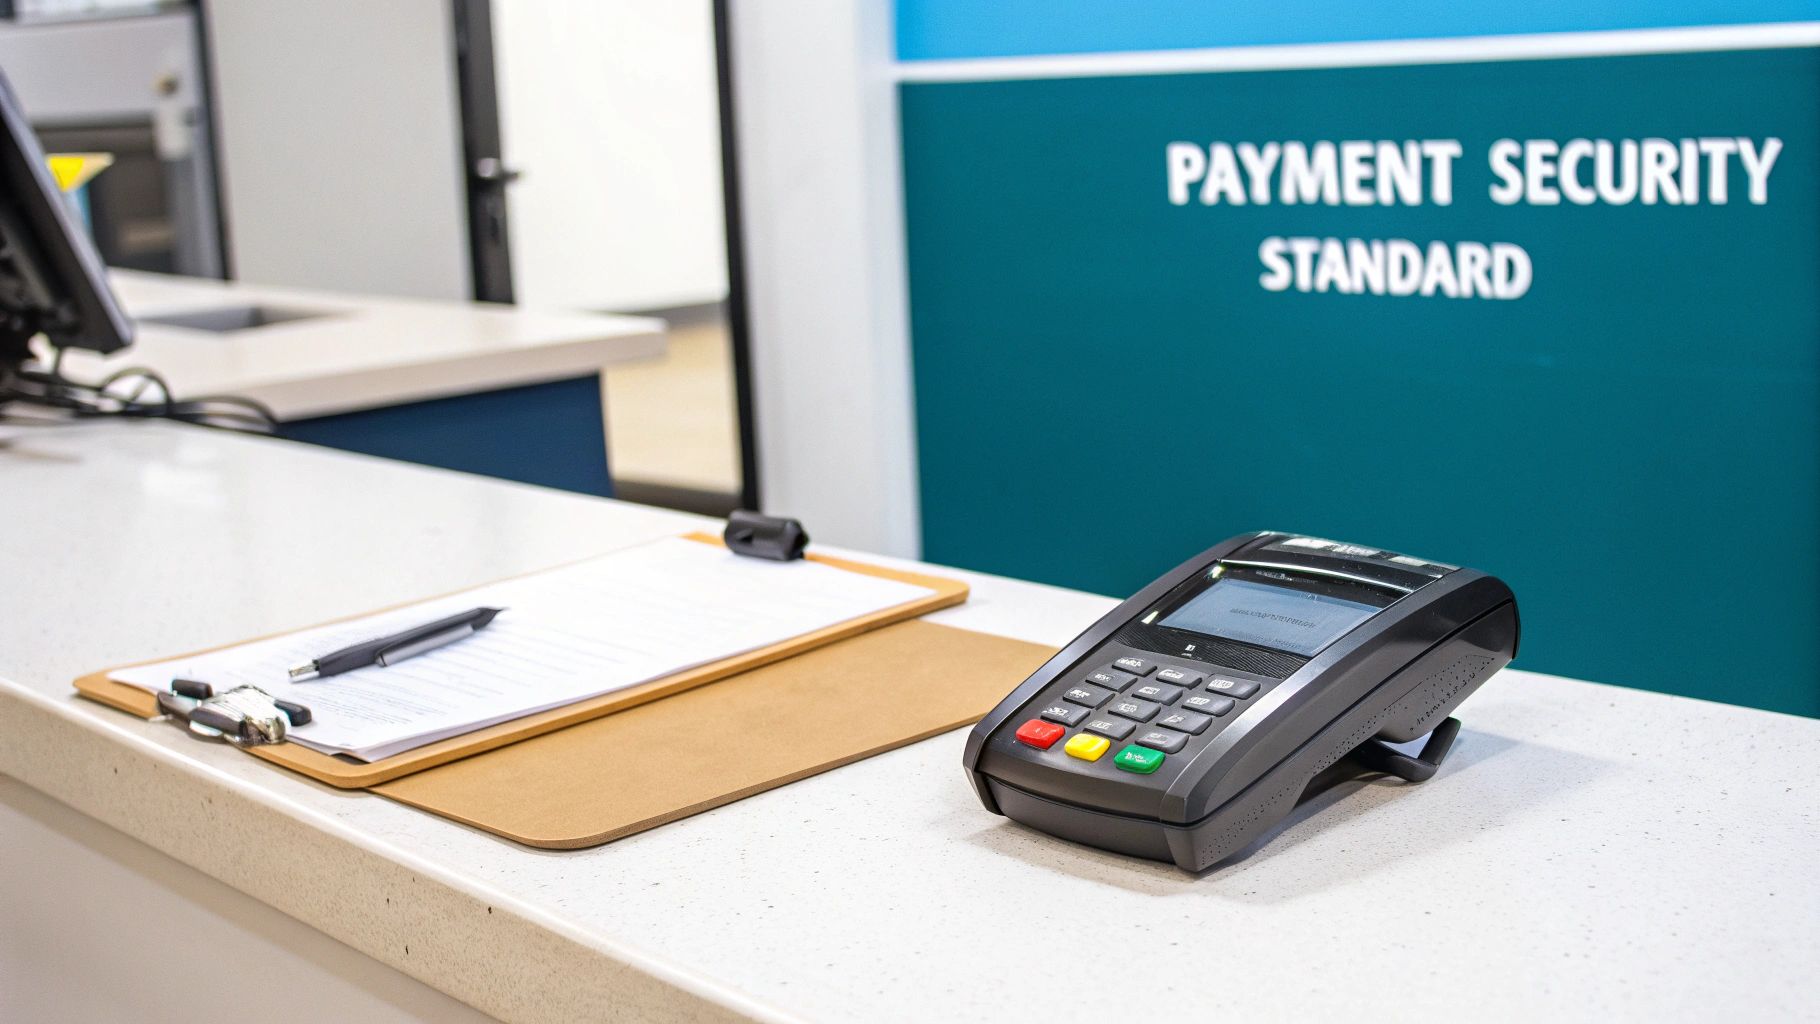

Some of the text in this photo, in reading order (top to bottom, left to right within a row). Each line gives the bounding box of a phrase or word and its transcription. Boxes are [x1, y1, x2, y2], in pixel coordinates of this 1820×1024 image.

[1166, 137, 1784, 207] PAYMENT SECURITY
[1258, 236, 1534, 300] STANDARD
